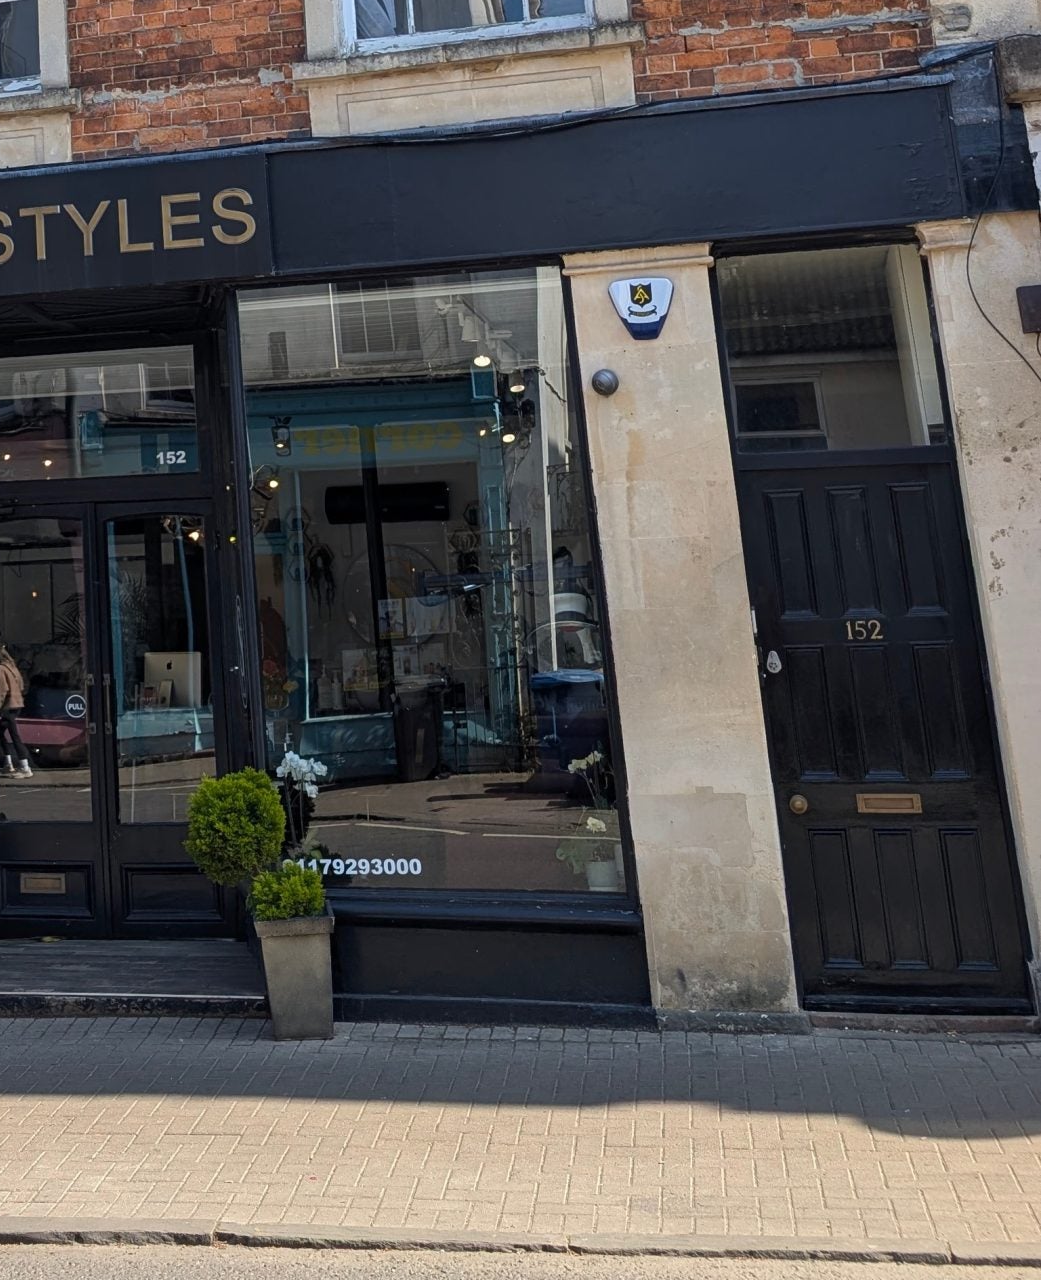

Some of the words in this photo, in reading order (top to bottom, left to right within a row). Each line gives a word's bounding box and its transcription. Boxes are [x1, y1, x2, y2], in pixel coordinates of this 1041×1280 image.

[156, 450, 187, 465] 152
[845, 619, 884, 640] 152
[68, 703, 84, 711] PULL
